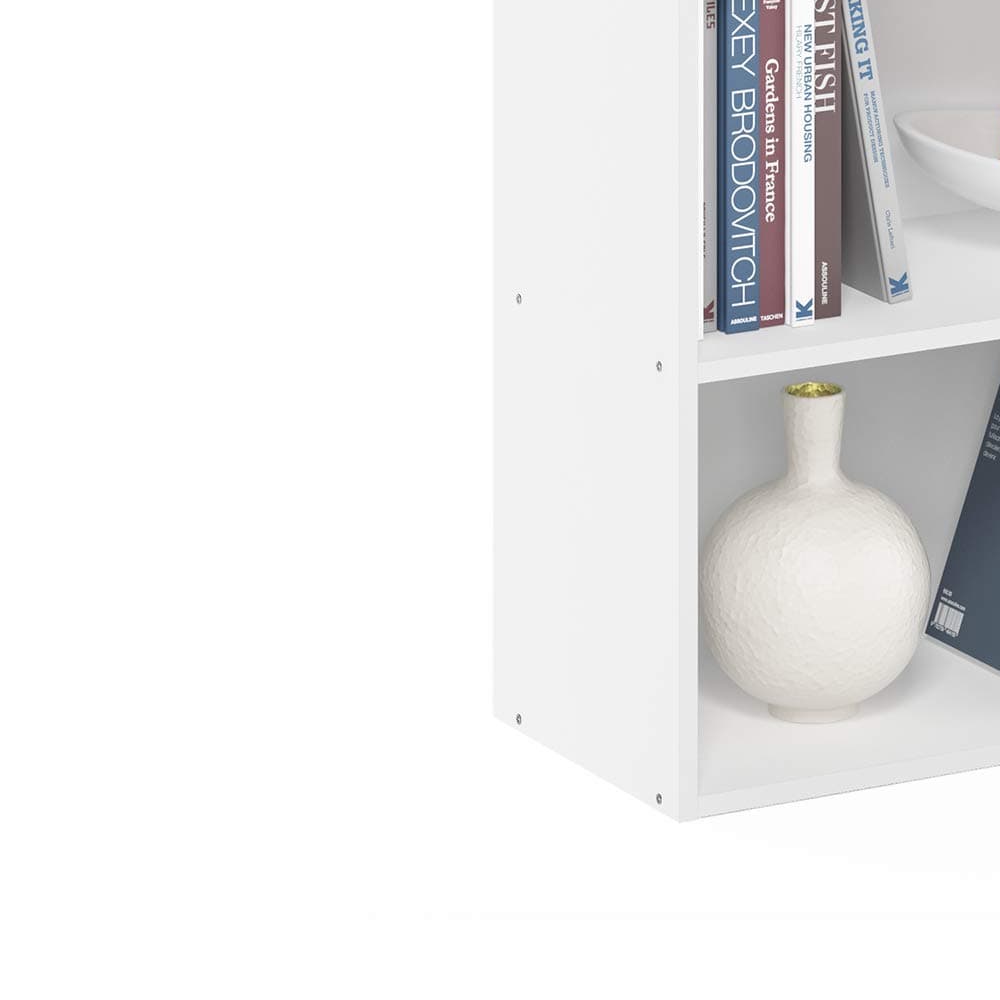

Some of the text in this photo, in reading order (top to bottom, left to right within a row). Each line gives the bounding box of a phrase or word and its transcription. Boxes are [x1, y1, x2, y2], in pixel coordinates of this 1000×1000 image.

[804, 24, 812, 163] NEW URBAN HOUSING
[814, 41, 836, 113] FISH
[858, 58, 874, 80] IT
[765, 58, 780, 222] Gardens in France
[731, 88, 756, 307] BRODOVITCH
[760, 314, 784, 322] TASCHEN
